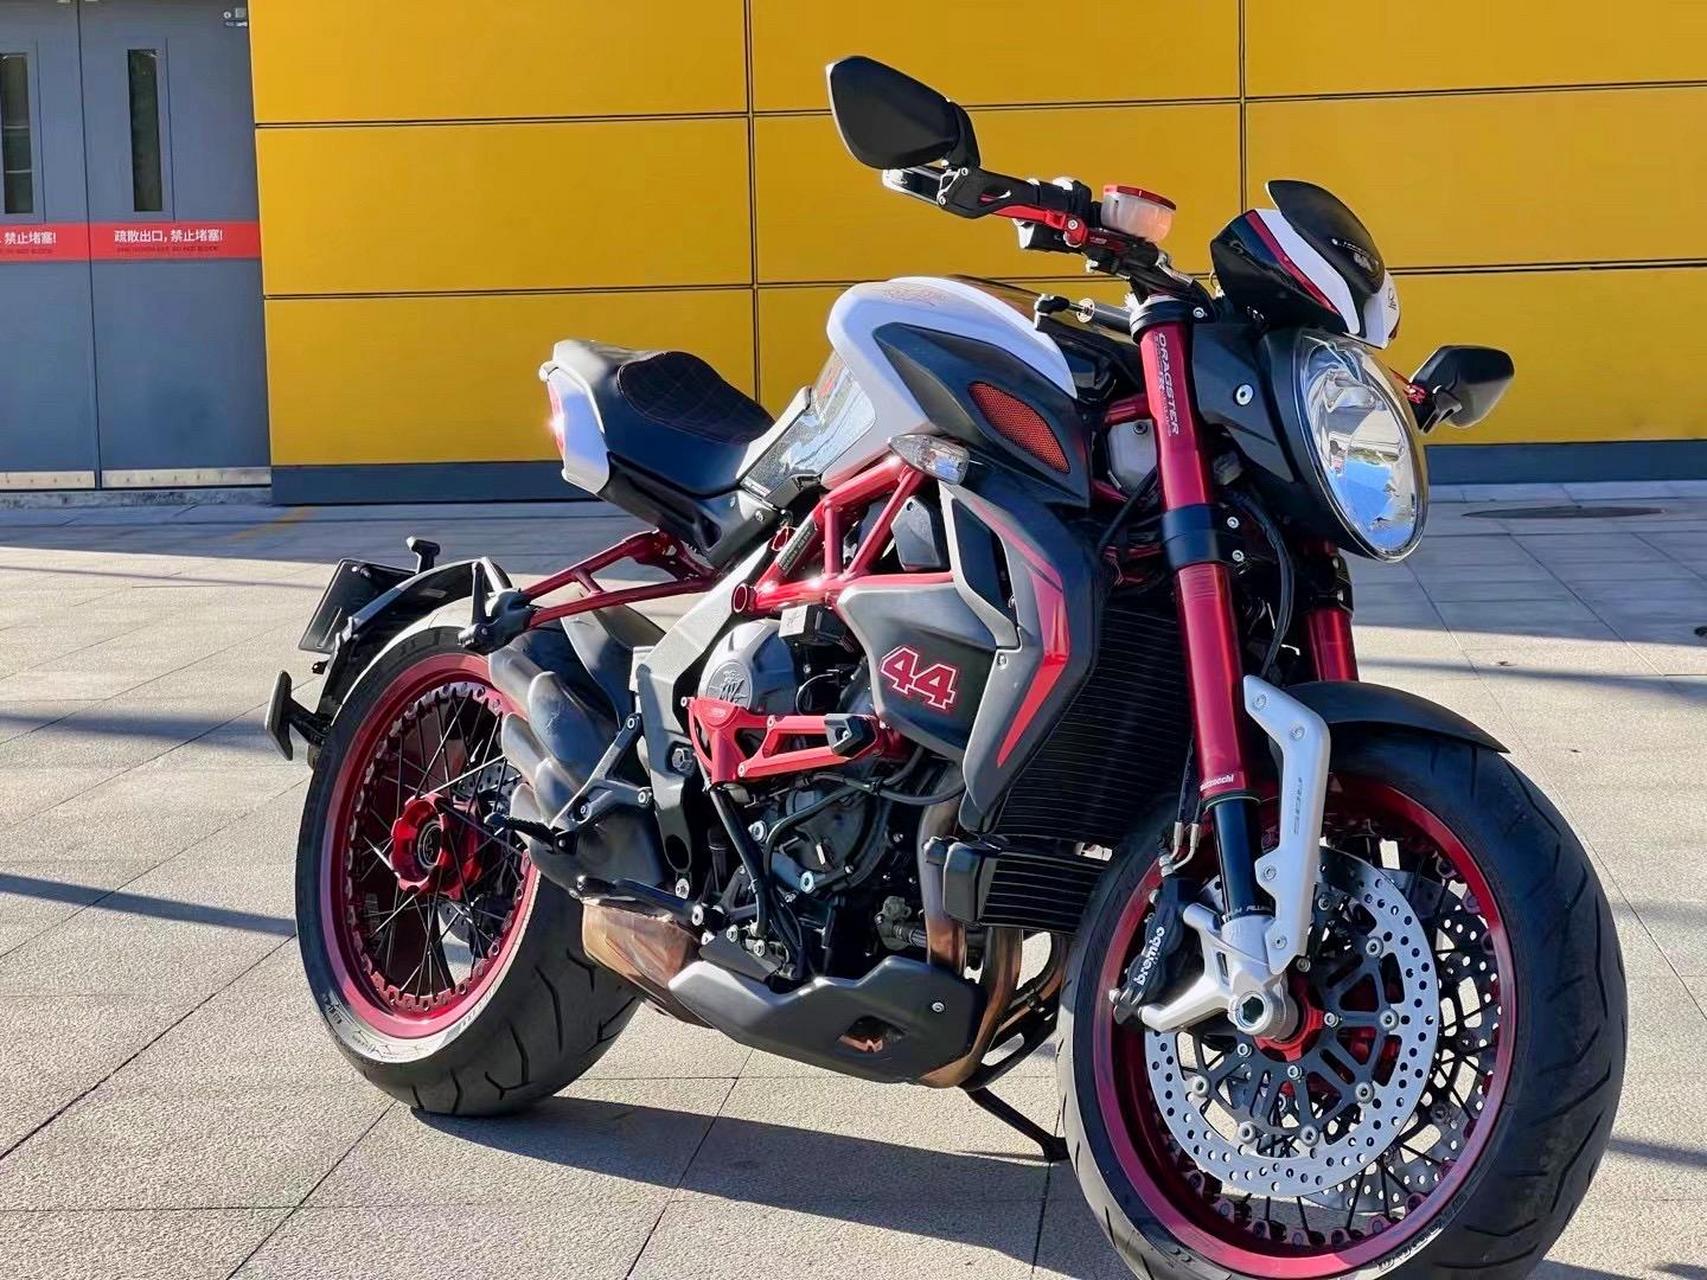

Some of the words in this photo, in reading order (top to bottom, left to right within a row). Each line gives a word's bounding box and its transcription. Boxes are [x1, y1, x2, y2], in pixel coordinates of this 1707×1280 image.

[1158, 332, 1180, 436] DRAGSTER
[880, 646, 957, 710] 44
[1133, 926, 1165, 986] brembo
